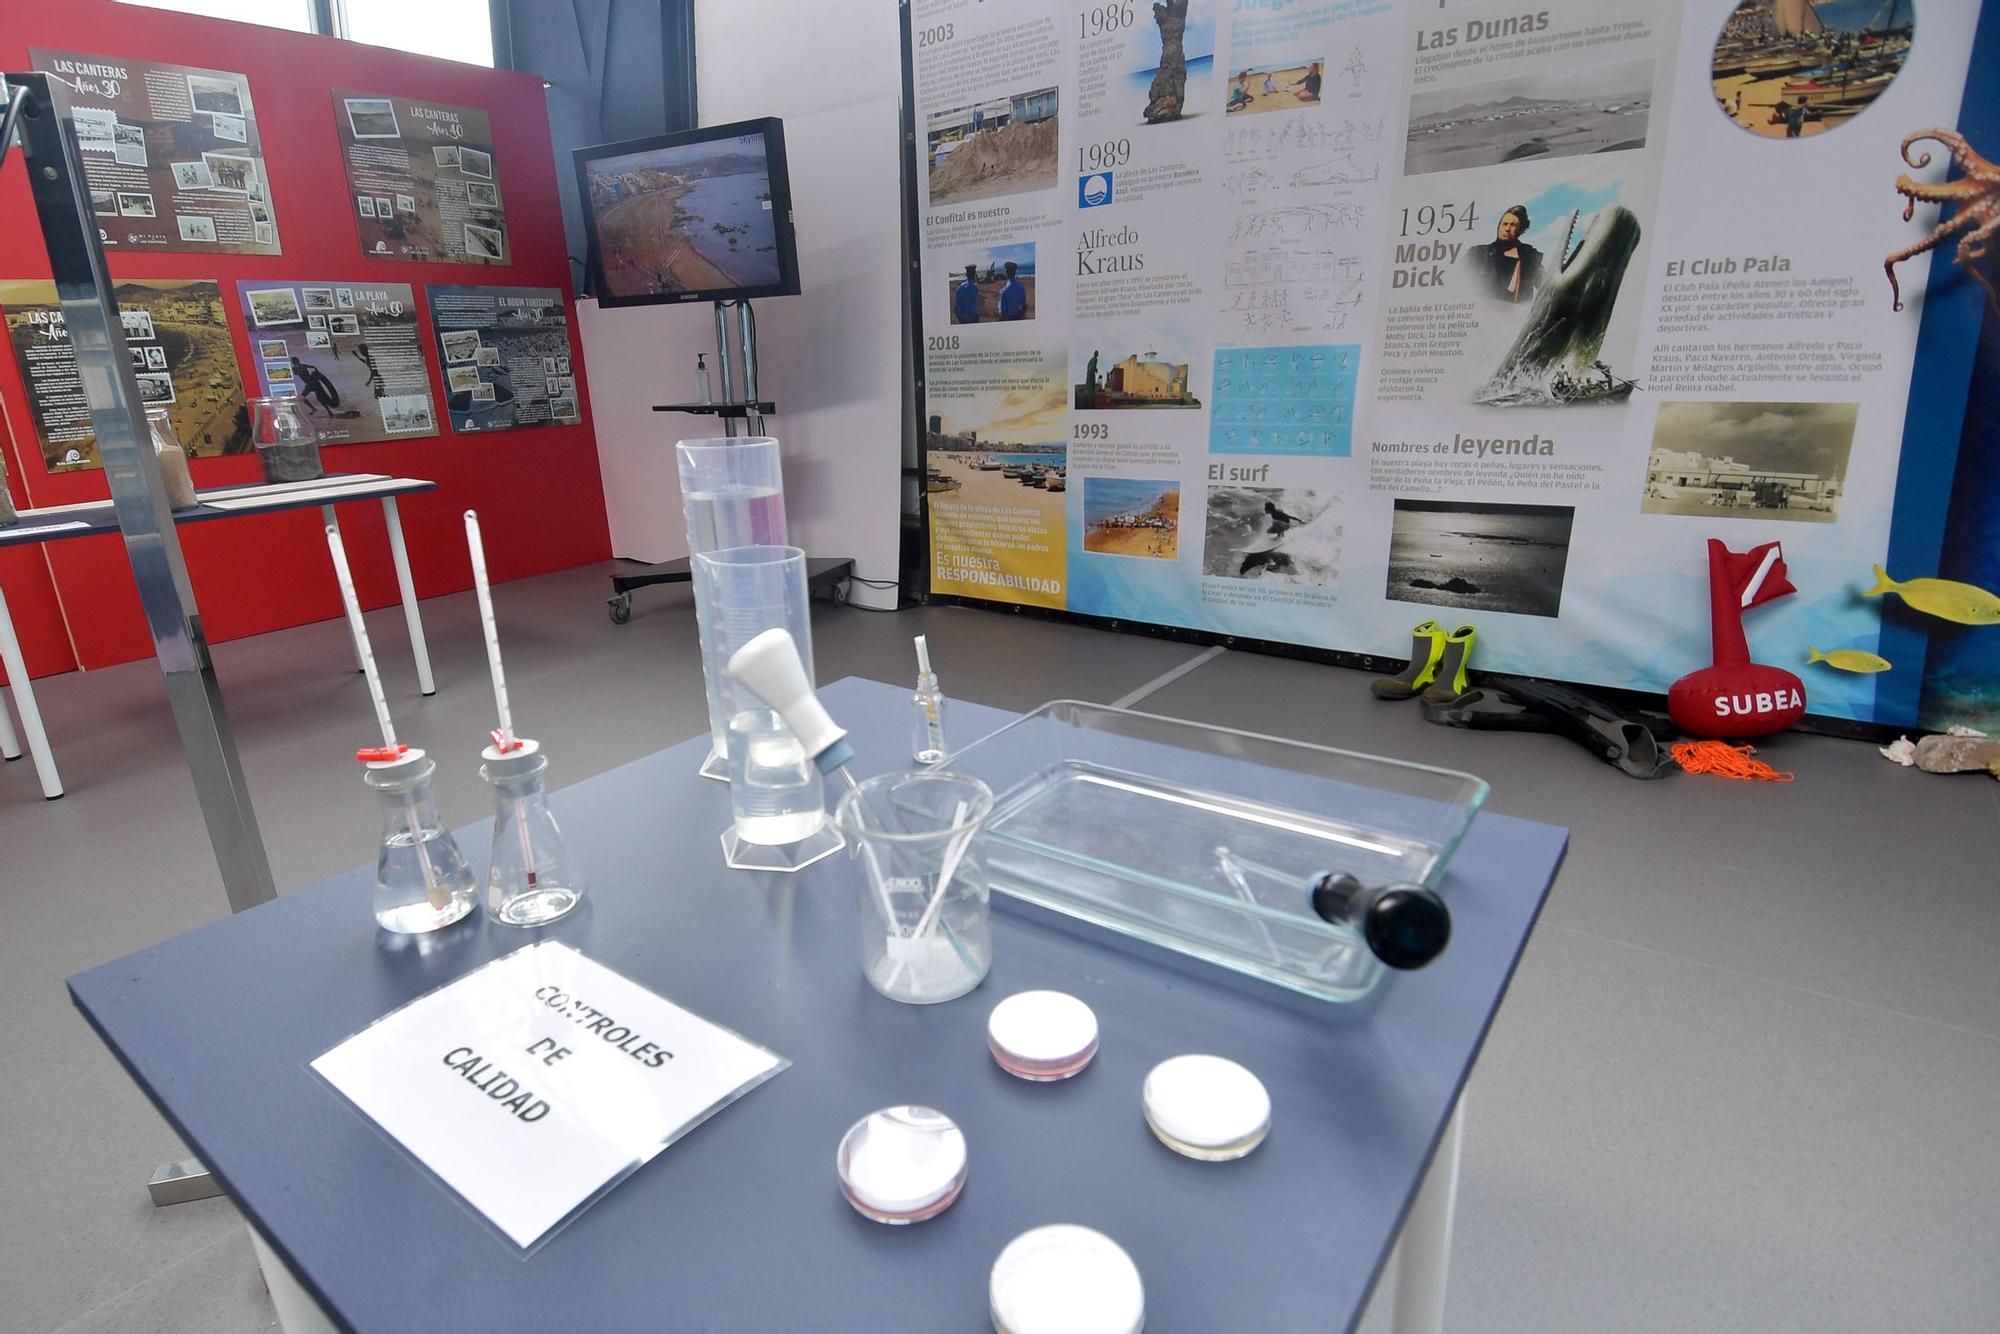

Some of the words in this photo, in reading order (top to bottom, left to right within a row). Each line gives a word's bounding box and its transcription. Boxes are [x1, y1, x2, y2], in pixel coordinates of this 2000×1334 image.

[1079, 0, 1134, 40] 1986
[1416, 28, 1458, 51] Las
[1466, 11, 1549, 43] Dunas
[918, 23, 954, 48] 2003
[52, 59, 75, 74] LAS
[75, 62, 128, 80] CANTERAS
[101, 80, 120, 98] 30
[410, 106, 424, 119] LAS
[424, 108, 459, 123] CANTERAS
[1078, 139, 1131, 172] 1989
[926, 216, 934, 226] El
[935, 211, 966, 225] Confital
[967, 211, 977, 221] es
[977, 206, 1010, 219] nuestro
[1400, 201, 1480, 237] 1954
[1076, 225, 1139, 250] Alfredo
[1076, 250, 1144, 276] Kraus
[1394, 239, 1462, 264] Moby
[1392, 266, 1445, 289] Dick
[1665, 260, 1685, 277] El
[1690, 257, 1737, 275] Club
[1743, 255, 1791, 273] Pala
[355, 290, 366, 301] LA
[366, 290, 389, 301] PLAYA
[28, 311, 49, 324] LAS
[39, 324, 69, 341] Año
[928, 335, 960, 351] 2018
[1073, 424, 1109, 439] 1993
[1371, 441, 1430, 454] Nombres
[1432, 441, 1449, 454] de
[1452, 433, 1555, 458] leyenda
[1207, 463, 1225, 480] El
[1229, 463, 1270, 481] surf
[936, 551, 950, 565] Es
[952, 554, 1001, 571] nuestra
[936, 566, 1062, 594] RESPONSABILIDAD
[1713, 687, 1803, 717] SUBEA
[525, 1036, 573, 1067] DE
[442, 1046, 551, 1124] CALIDAD
